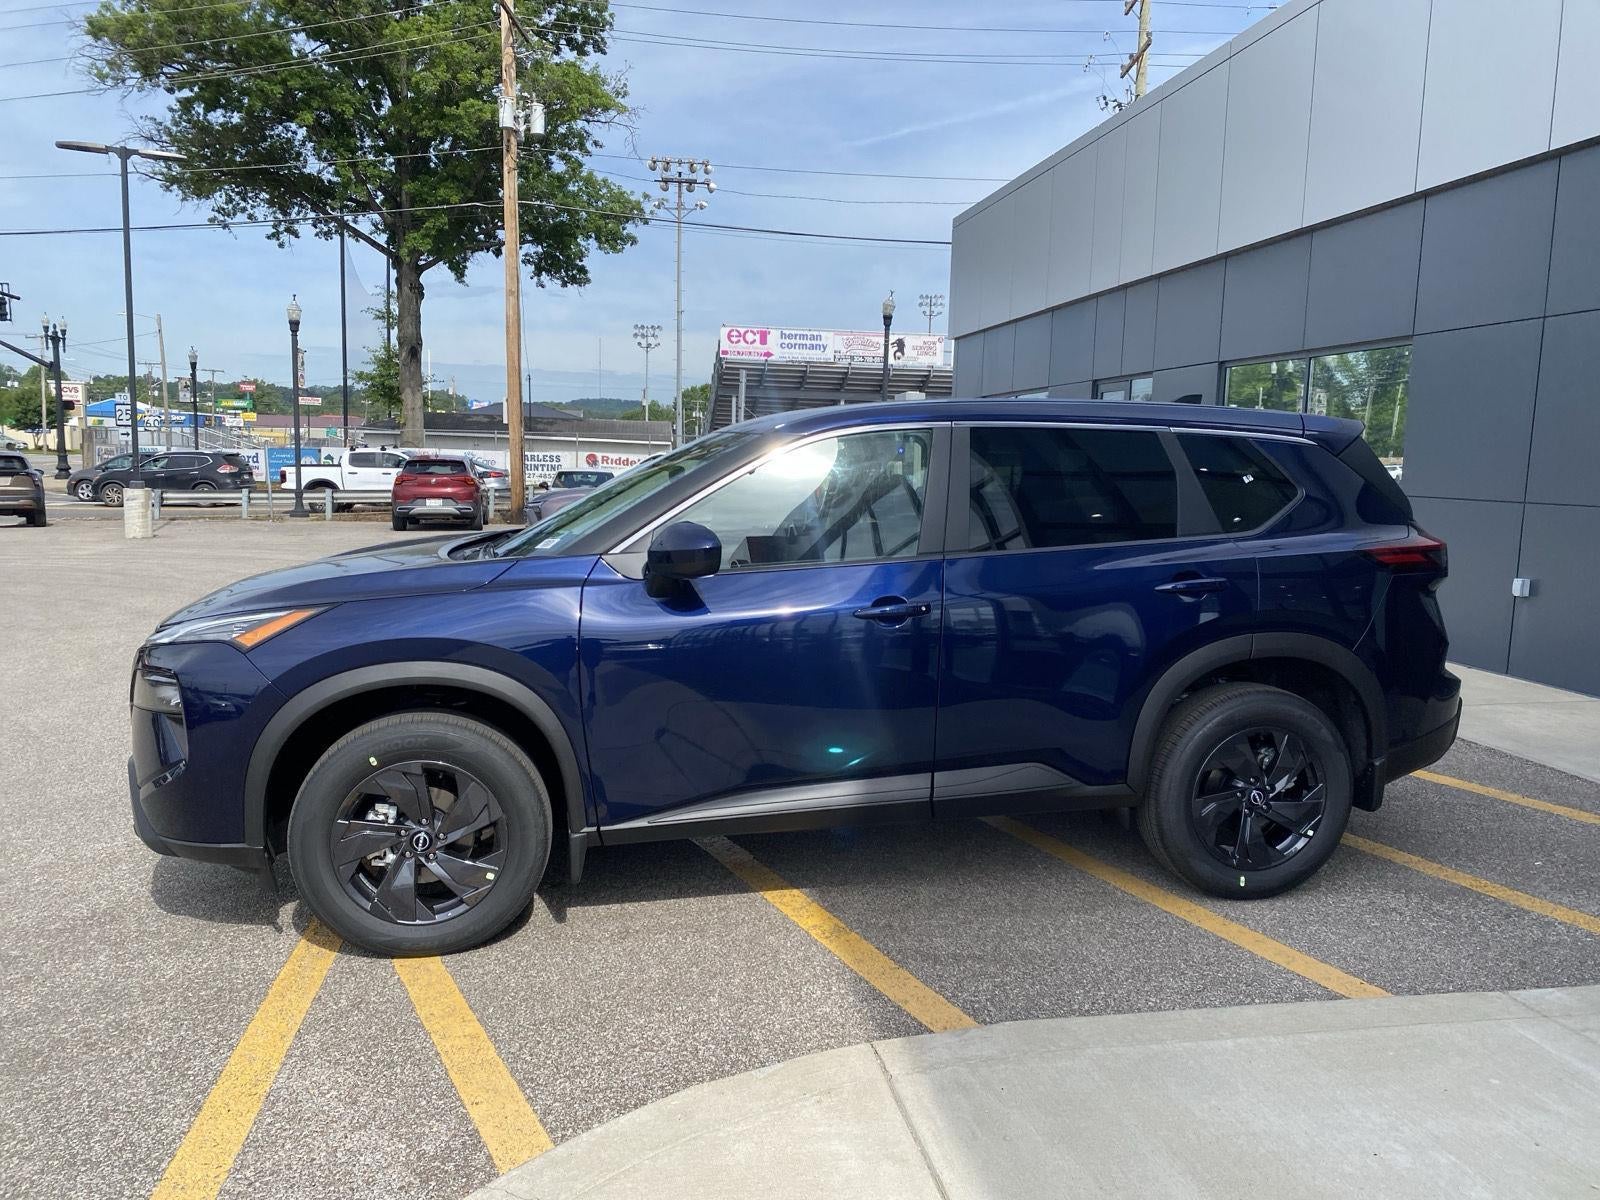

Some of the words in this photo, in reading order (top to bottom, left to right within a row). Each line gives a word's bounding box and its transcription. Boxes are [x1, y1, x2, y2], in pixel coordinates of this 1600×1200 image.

[780, 331, 822, 341] herman
[780, 343, 828, 352] cormany
[116, 409, 131, 420] 25
[145, 419, 160, 428] 60
[600, 455, 641, 466] Ridde
